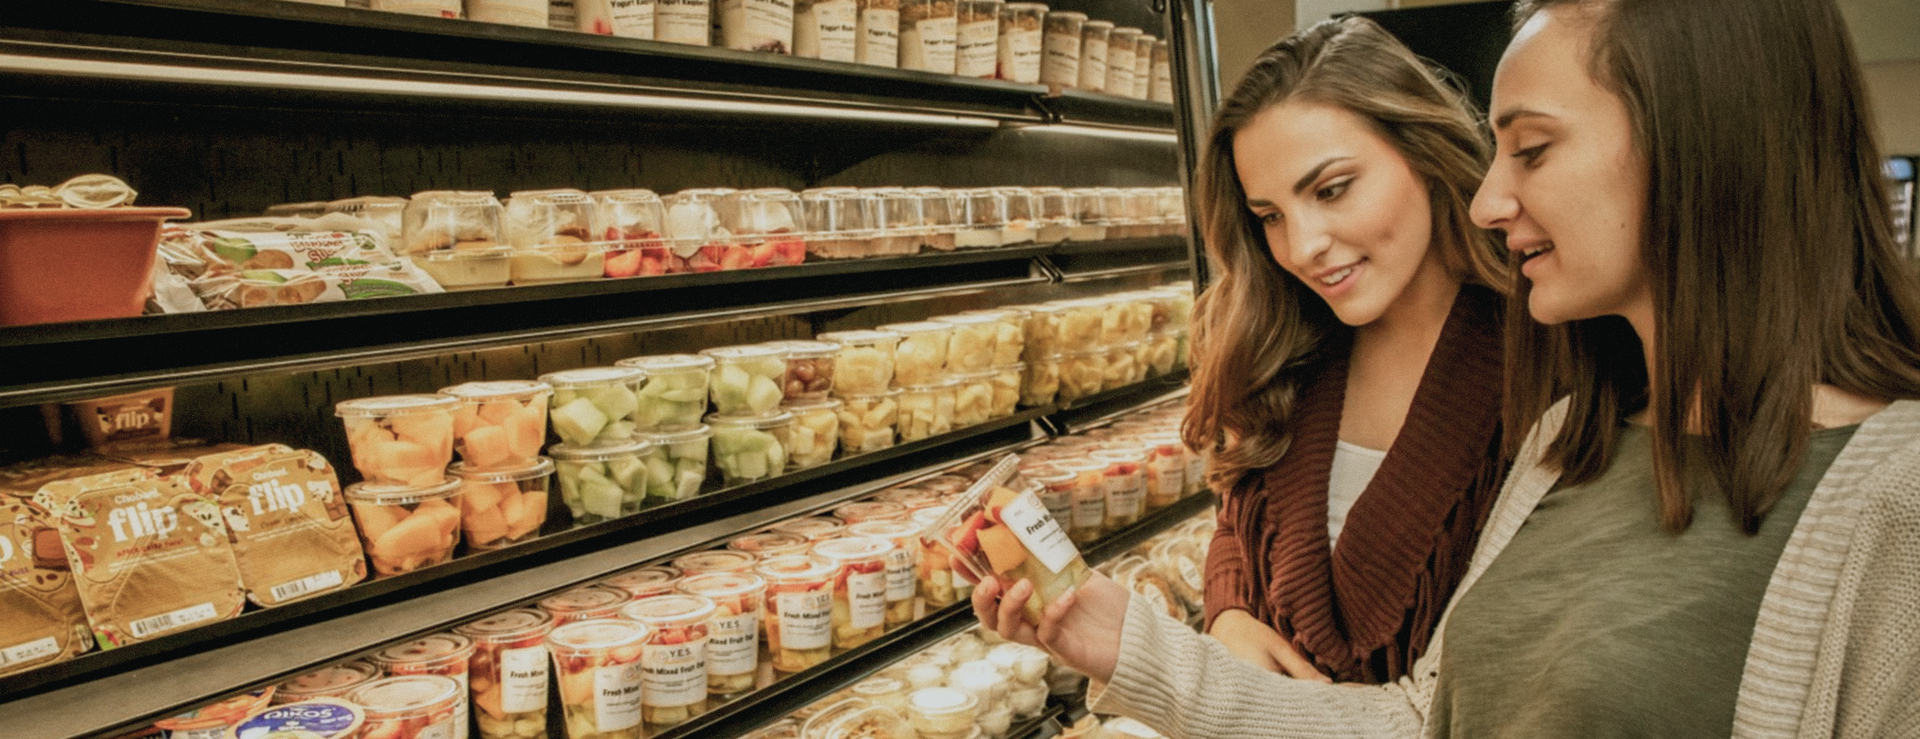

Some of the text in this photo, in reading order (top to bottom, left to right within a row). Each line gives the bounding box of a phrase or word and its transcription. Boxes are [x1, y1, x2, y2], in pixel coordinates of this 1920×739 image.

[247, 478, 305, 516] flip
[106, 501, 178, 543] flip
[1025, 518, 1045, 535] Fresh
[656, 667, 679, 675] Mixed
[680, 664, 695, 673] Fruit
[603, 689, 622, 697] Fresh
